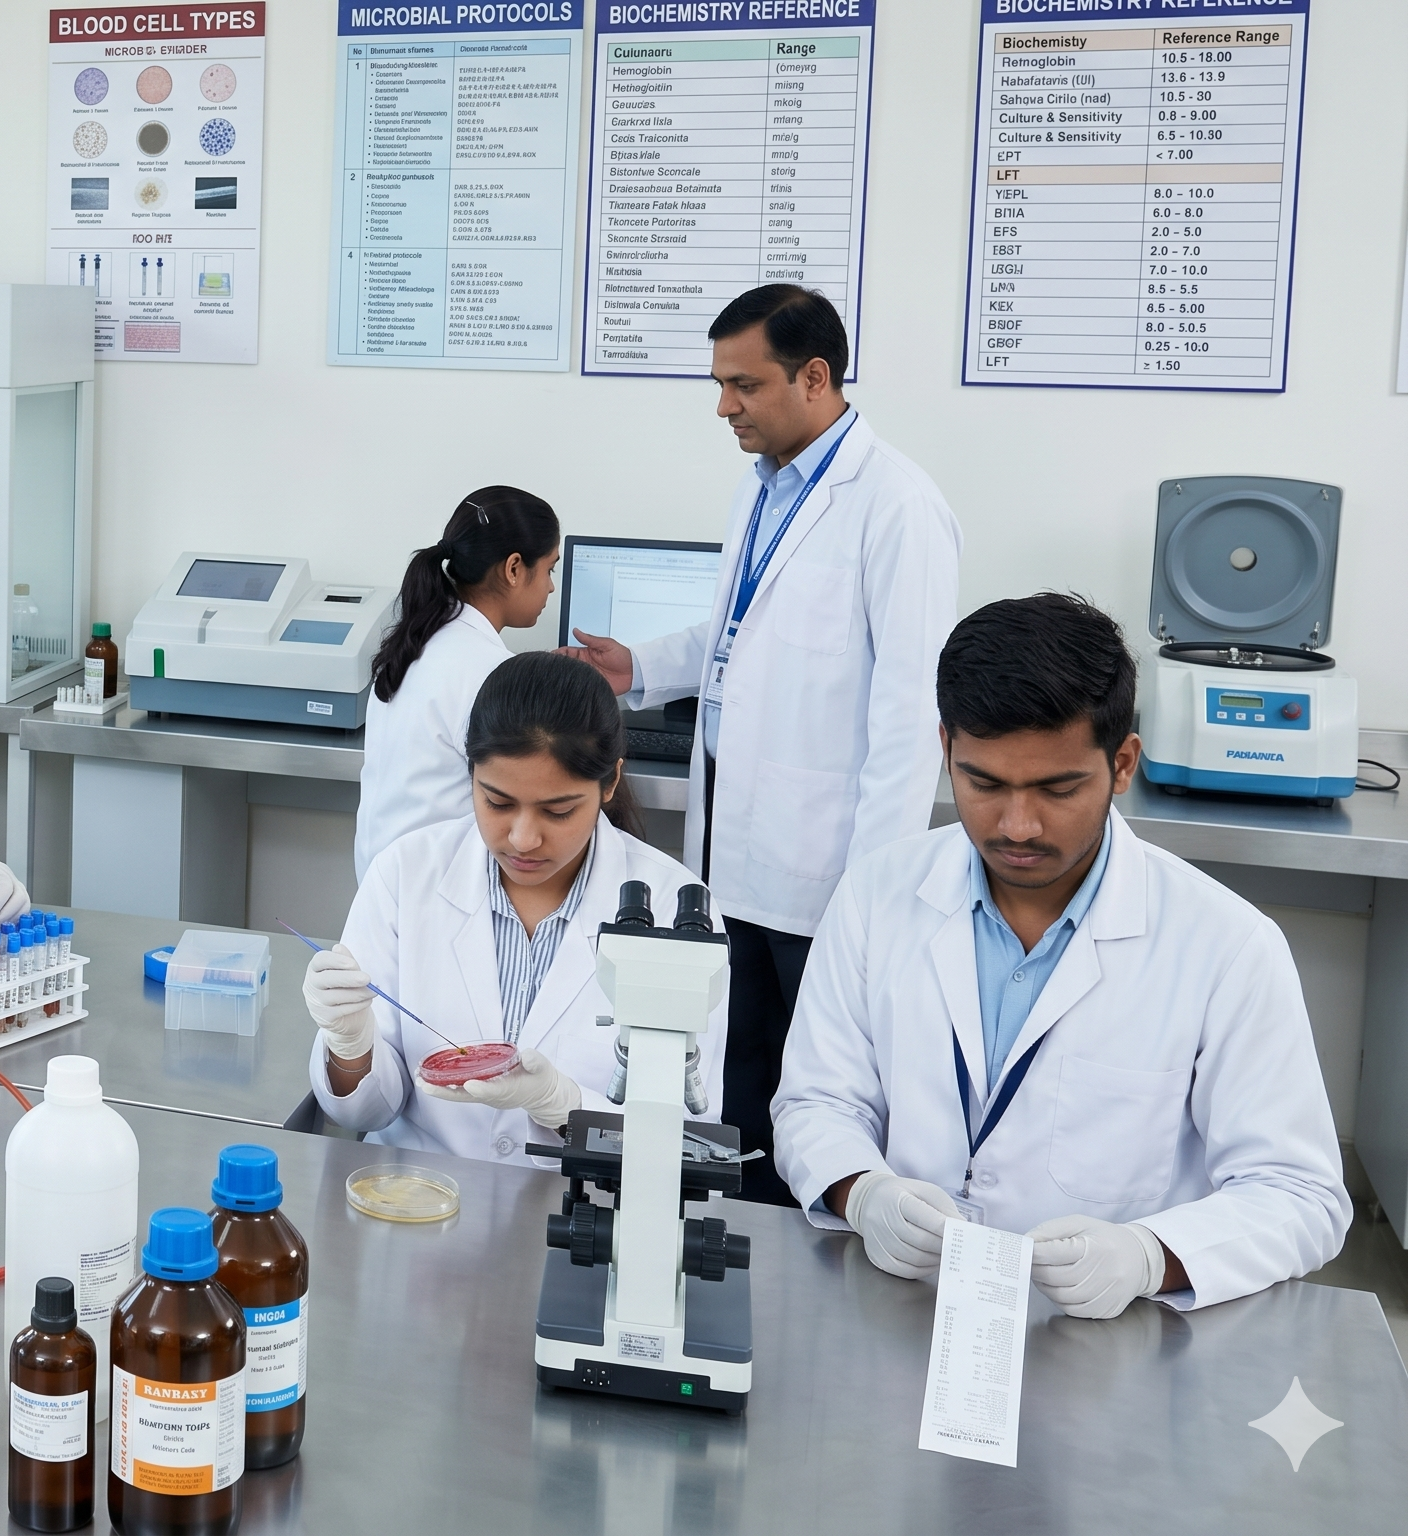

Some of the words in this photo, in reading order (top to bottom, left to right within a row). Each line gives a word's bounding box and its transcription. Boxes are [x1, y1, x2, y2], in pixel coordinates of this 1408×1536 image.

[352, 6, 451, 27] MICROBIAL
[457, 2, 572, 24] PROTOCOLS
[609, 2, 744, 24] BIOCHEMISTRY
[749, 0, 860, 20] REFERENCE
[58, 15, 127, 36] BLOOD
[133, 13, 184, 33] CELL
[190, 10, 256, 31] TYPES
[1163, 32, 1231, 44] Reference
[1236, 30, 1280, 44] Range
[777, 42, 816, 57] Range
[1162, 52, 1187, 63] 10.5
[1199, 51, 1232, 63] 18.00
[355, 62, 360, 70] 1
[613, 66, 672, 77] Hemoglobin
[1161, 72, 1186, 83] 13.6
[1199, 71, 1225, 82] 13.9
[1160, 91, 1185, 102] 10.5
[1196, 91, 1212, 101] 30
[999, 113, 1043, 123] Culture
[1046, 112, 1055, 123] &
[1059, 111, 1123, 124] Sensitivity
[1158, 110, 1177, 121] 0.8
[1190, 110, 1217, 121] 9.00
[998, 132, 1042, 143] Culture
[1045, 132, 1054, 143] &
[1058, 131, 1122, 144] Sensitivity
[1157, 130, 1176, 141] 6.5
[1189, 130, 1222, 140] 10.30
[1167, 149, 1193, 160] 7.00
[350, 173, 356, 181] 2
[997, 170, 1020, 181] LFT
[1154, 188, 1172, 198] 8.0
[1189, 188, 1214, 198] 10.0
[1153, 208, 1171, 218] 6.0
[1184, 207, 1203, 218] 8.0
[993, 226, 1018, 237] EFS
[1151, 226, 1170, 237] 2.0
[1183, 226, 1202, 237] 5.0
[347, 251, 353, 259] 4
[1150, 246, 1168, 256] 2.0
[1182, 246, 1200, 256] 7.0
[1149, 265, 1168, 275] 7.0
[1182, 265, 1208, 275] 10.0
[1148, 284, 1166, 294] 8.5
[1180, 284, 1198, 294] 5.5
[1179, 303, 1205, 314] 5.00
[1145, 322, 1164, 332] 8.0
[1178, 322, 1207, 333] 5.0.5
[1145, 341, 1170, 351] 0.25
[986, 356, 1010, 367] LFT
[1156, 360, 1180, 371] 1.50
